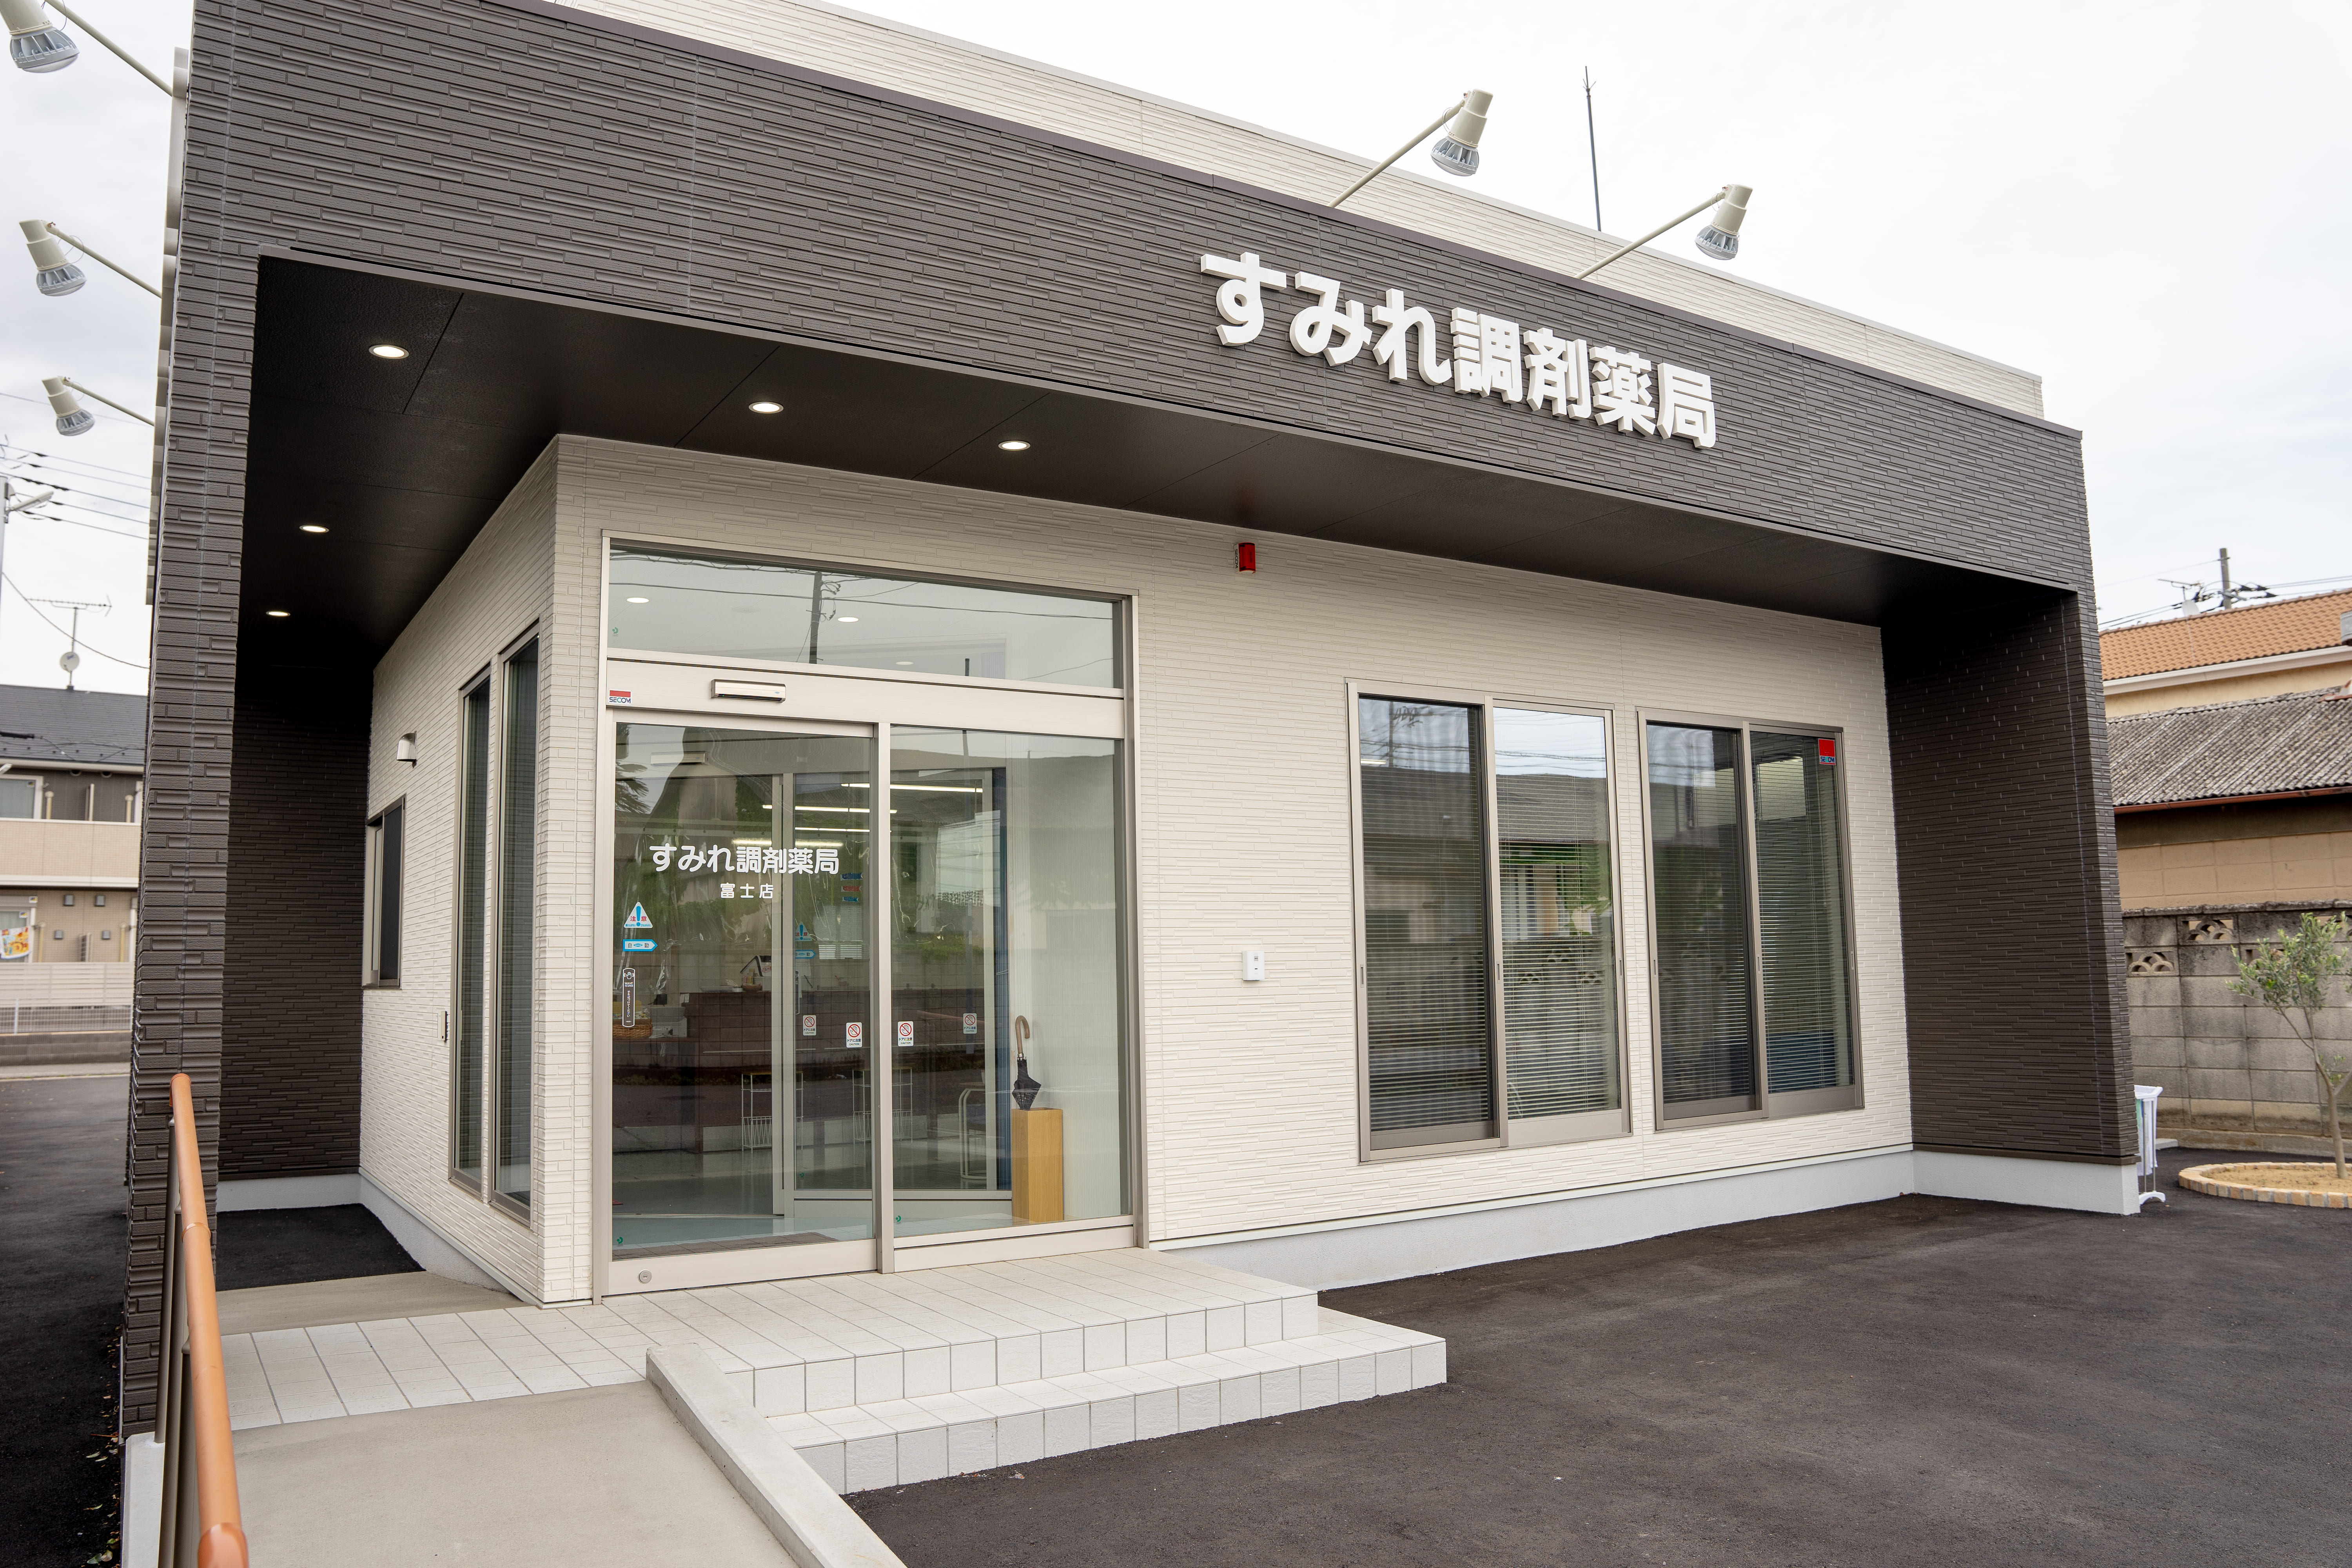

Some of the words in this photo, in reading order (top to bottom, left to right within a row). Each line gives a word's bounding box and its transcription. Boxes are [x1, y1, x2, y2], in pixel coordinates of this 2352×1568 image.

[1200, 251, 1716, 449] すみれ調剤薬局
[649, 842, 839, 875] すみれ調剤薬局
[720, 882, 774, 899] 富士店
